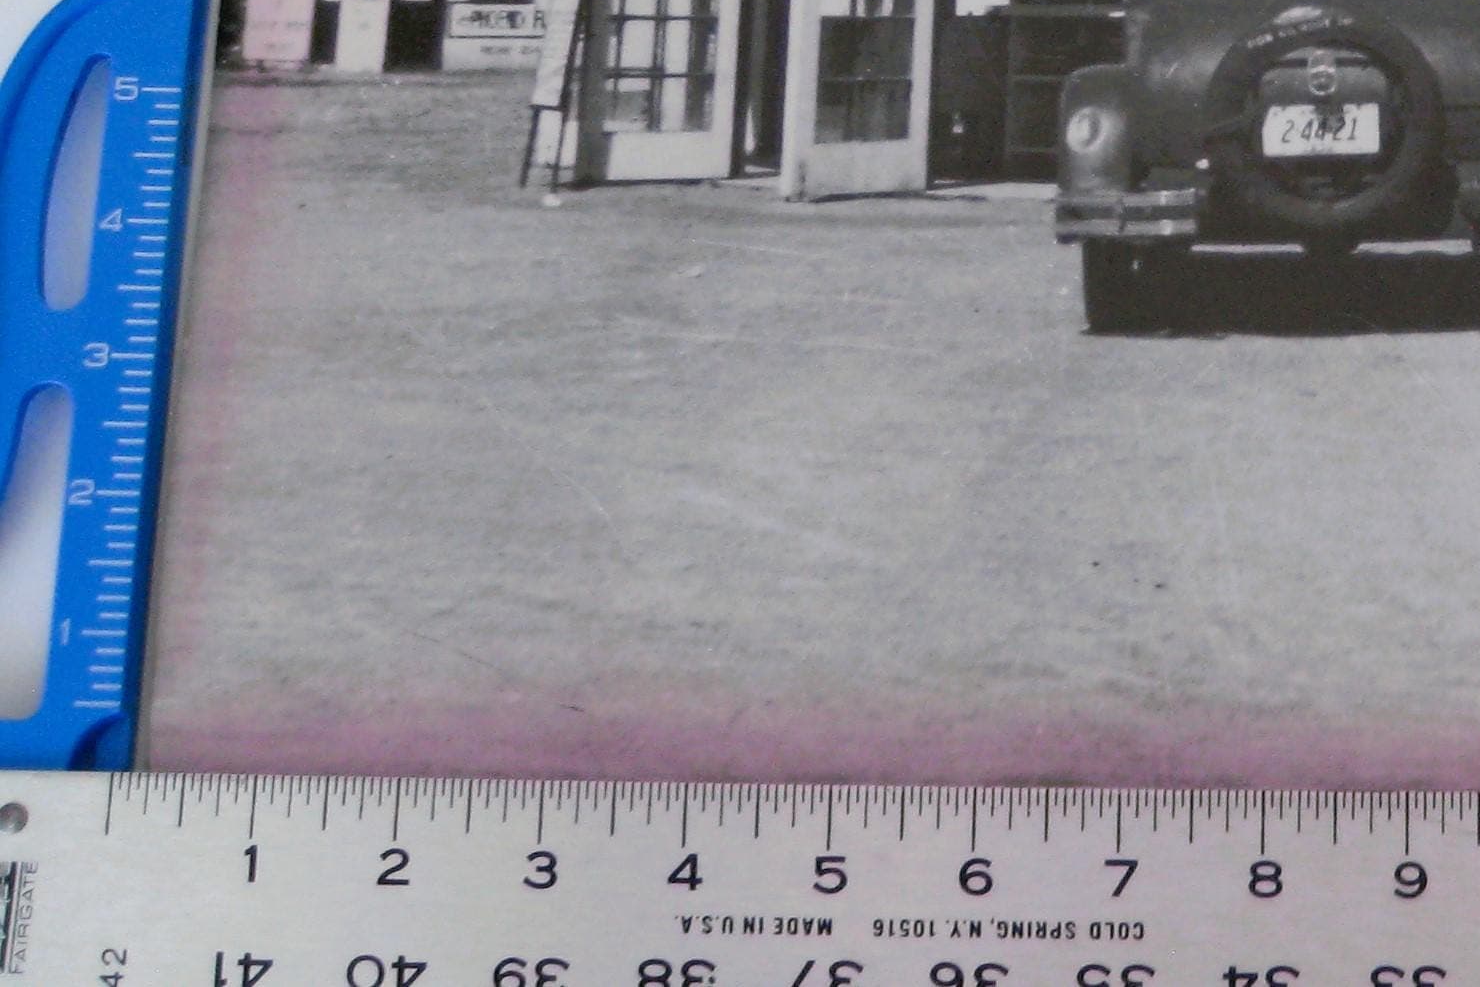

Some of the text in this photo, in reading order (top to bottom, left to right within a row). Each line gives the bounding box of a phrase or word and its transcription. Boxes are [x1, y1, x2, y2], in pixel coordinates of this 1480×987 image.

[114, 76, 139, 102] 5
[98, 209, 125, 233] 4
[83, 343, 110, 368] 3
[68, 480, 97, 506] 2
[59, 619, 70, 645] 1
[244, 845, 257, 883] 1
[376, 848, 410, 886] 2
[523, 851, 558, 889] 3
[667, 853, 703, 891] 4
[813, 856, 847, 894] 5
[959, 858, 993, 896] 6
[1104, 859, 1138, 897] 7
[1248, 860, 1283, 898] 8
[1394, 861, 1428, 899] 9
[10, 861, 38, 974] FAIRGATE
[675, 916, 832, 936] MADE IN U.S.A.
[873, 918, 1144, 941] COLD SPRING, N.Y. 10516
[214, 952, 273, 987] 41
[346, 955, 427, 987] 40
[493, 957, 570, 987] 39
[638, 959, 716, 987] 38
[791, 960, 863, 987] 37
